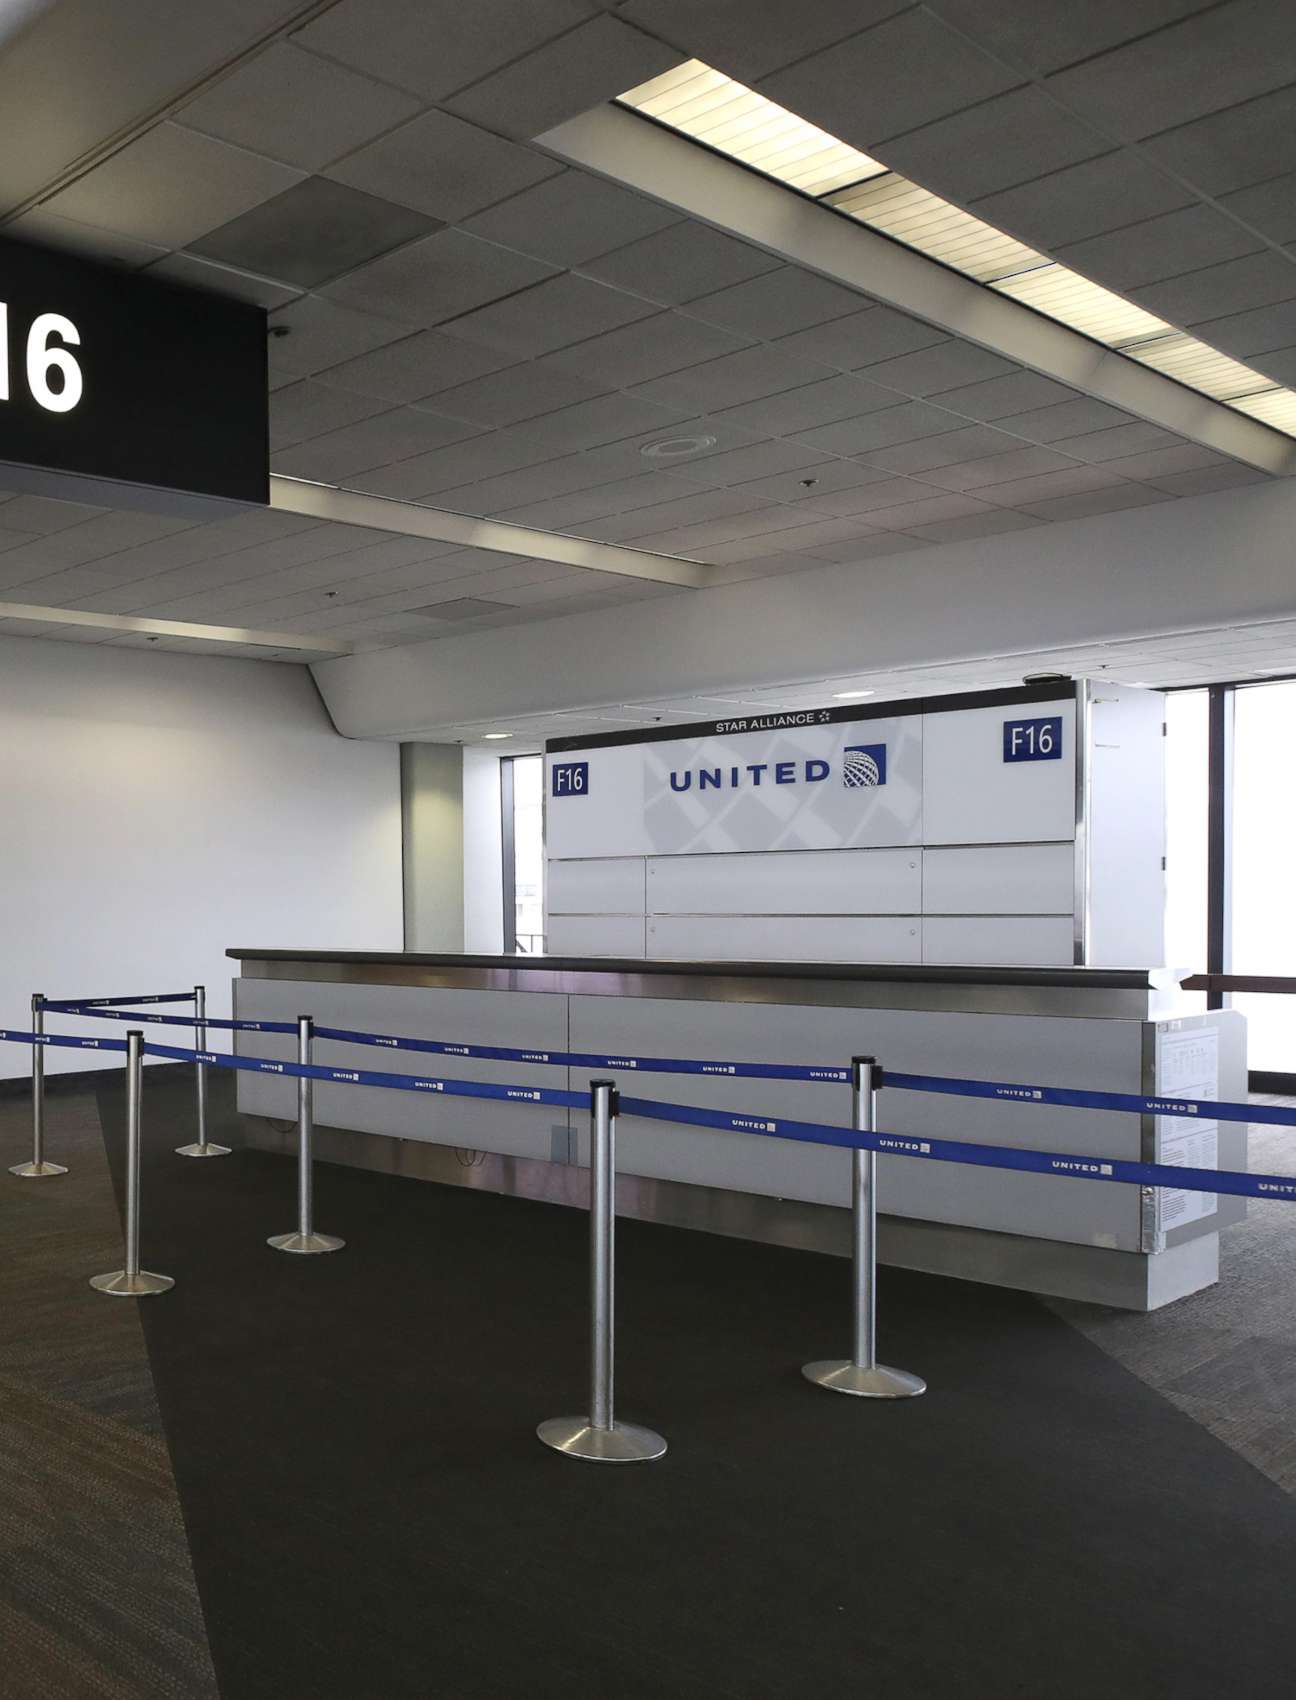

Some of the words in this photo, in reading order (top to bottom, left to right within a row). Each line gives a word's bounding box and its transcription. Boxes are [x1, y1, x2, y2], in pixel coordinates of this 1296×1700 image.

[715, 719, 747, 734] STAR
[750, 712, 815, 729] ALLIANCE
[1011, 724, 1053, 756] F16
[556, 767, 583, 793] F16
[669, 759, 830, 792] UNITED
[809, 1071, 839, 1079] UNITED
[414, 1081, 438, 1090] UNITED
[507, 1090, 533, 1099] UNITED
[996, 1088, 1032, 1098] UNITED
[1146, 1102, 1186, 1112] UNITED
[731, 1119, 766, 1130] UNITED
[879, 1139, 919, 1151] UNITED
[1051, 1160, 1099, 1173] UNITED
